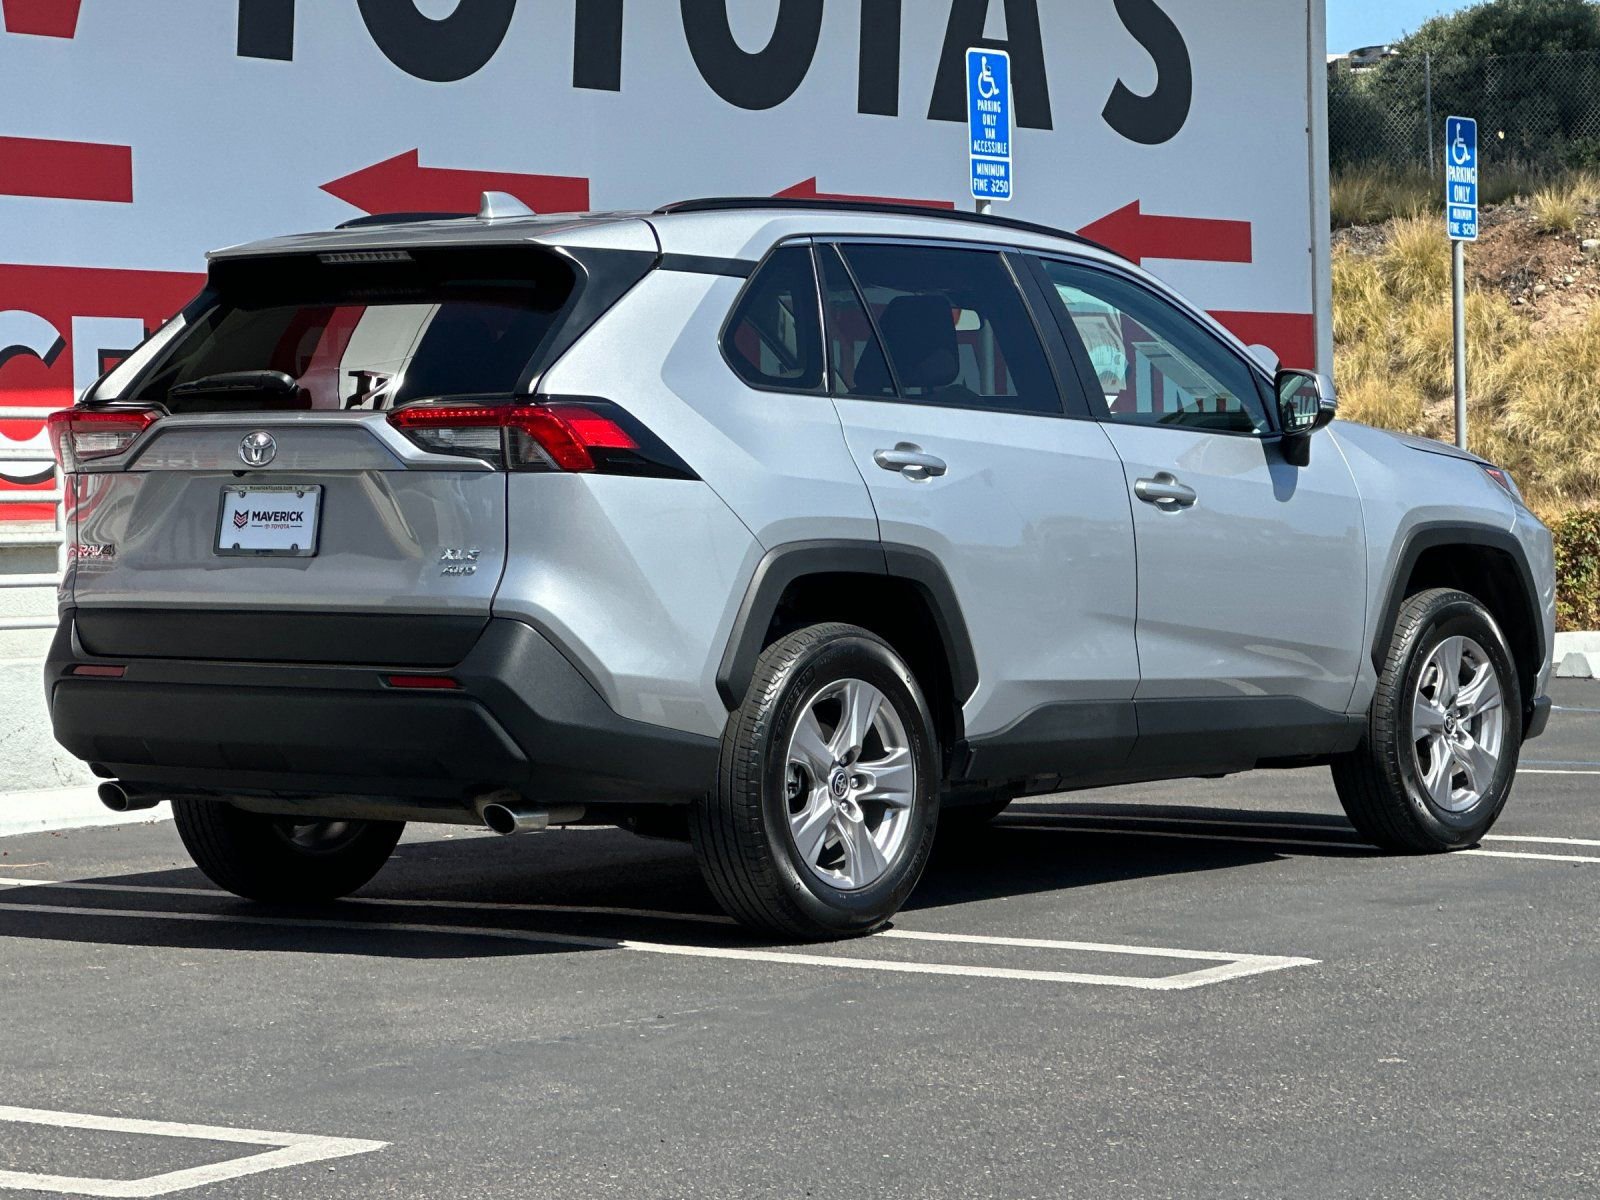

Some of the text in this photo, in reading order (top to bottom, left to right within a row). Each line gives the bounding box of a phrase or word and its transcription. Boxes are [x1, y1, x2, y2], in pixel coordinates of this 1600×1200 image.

[977, 99, 1001, 113] PARKING
[982, 114, 997, 126] ONLY
[984, 127, 996, 140] VAN
[973, 140, 1007, 155] ACCESSIBLE
[976, 162, 1005, 177] MINIMUM
[1448, 165, 1475, 185] PARKING
[973, 178, 1009, 193] FINE $250
[1453, 184, 1471, 203] ONLY
[1449, 221, 1460, 234] FINE
[251, 510, 304, 522] MAVERICK
